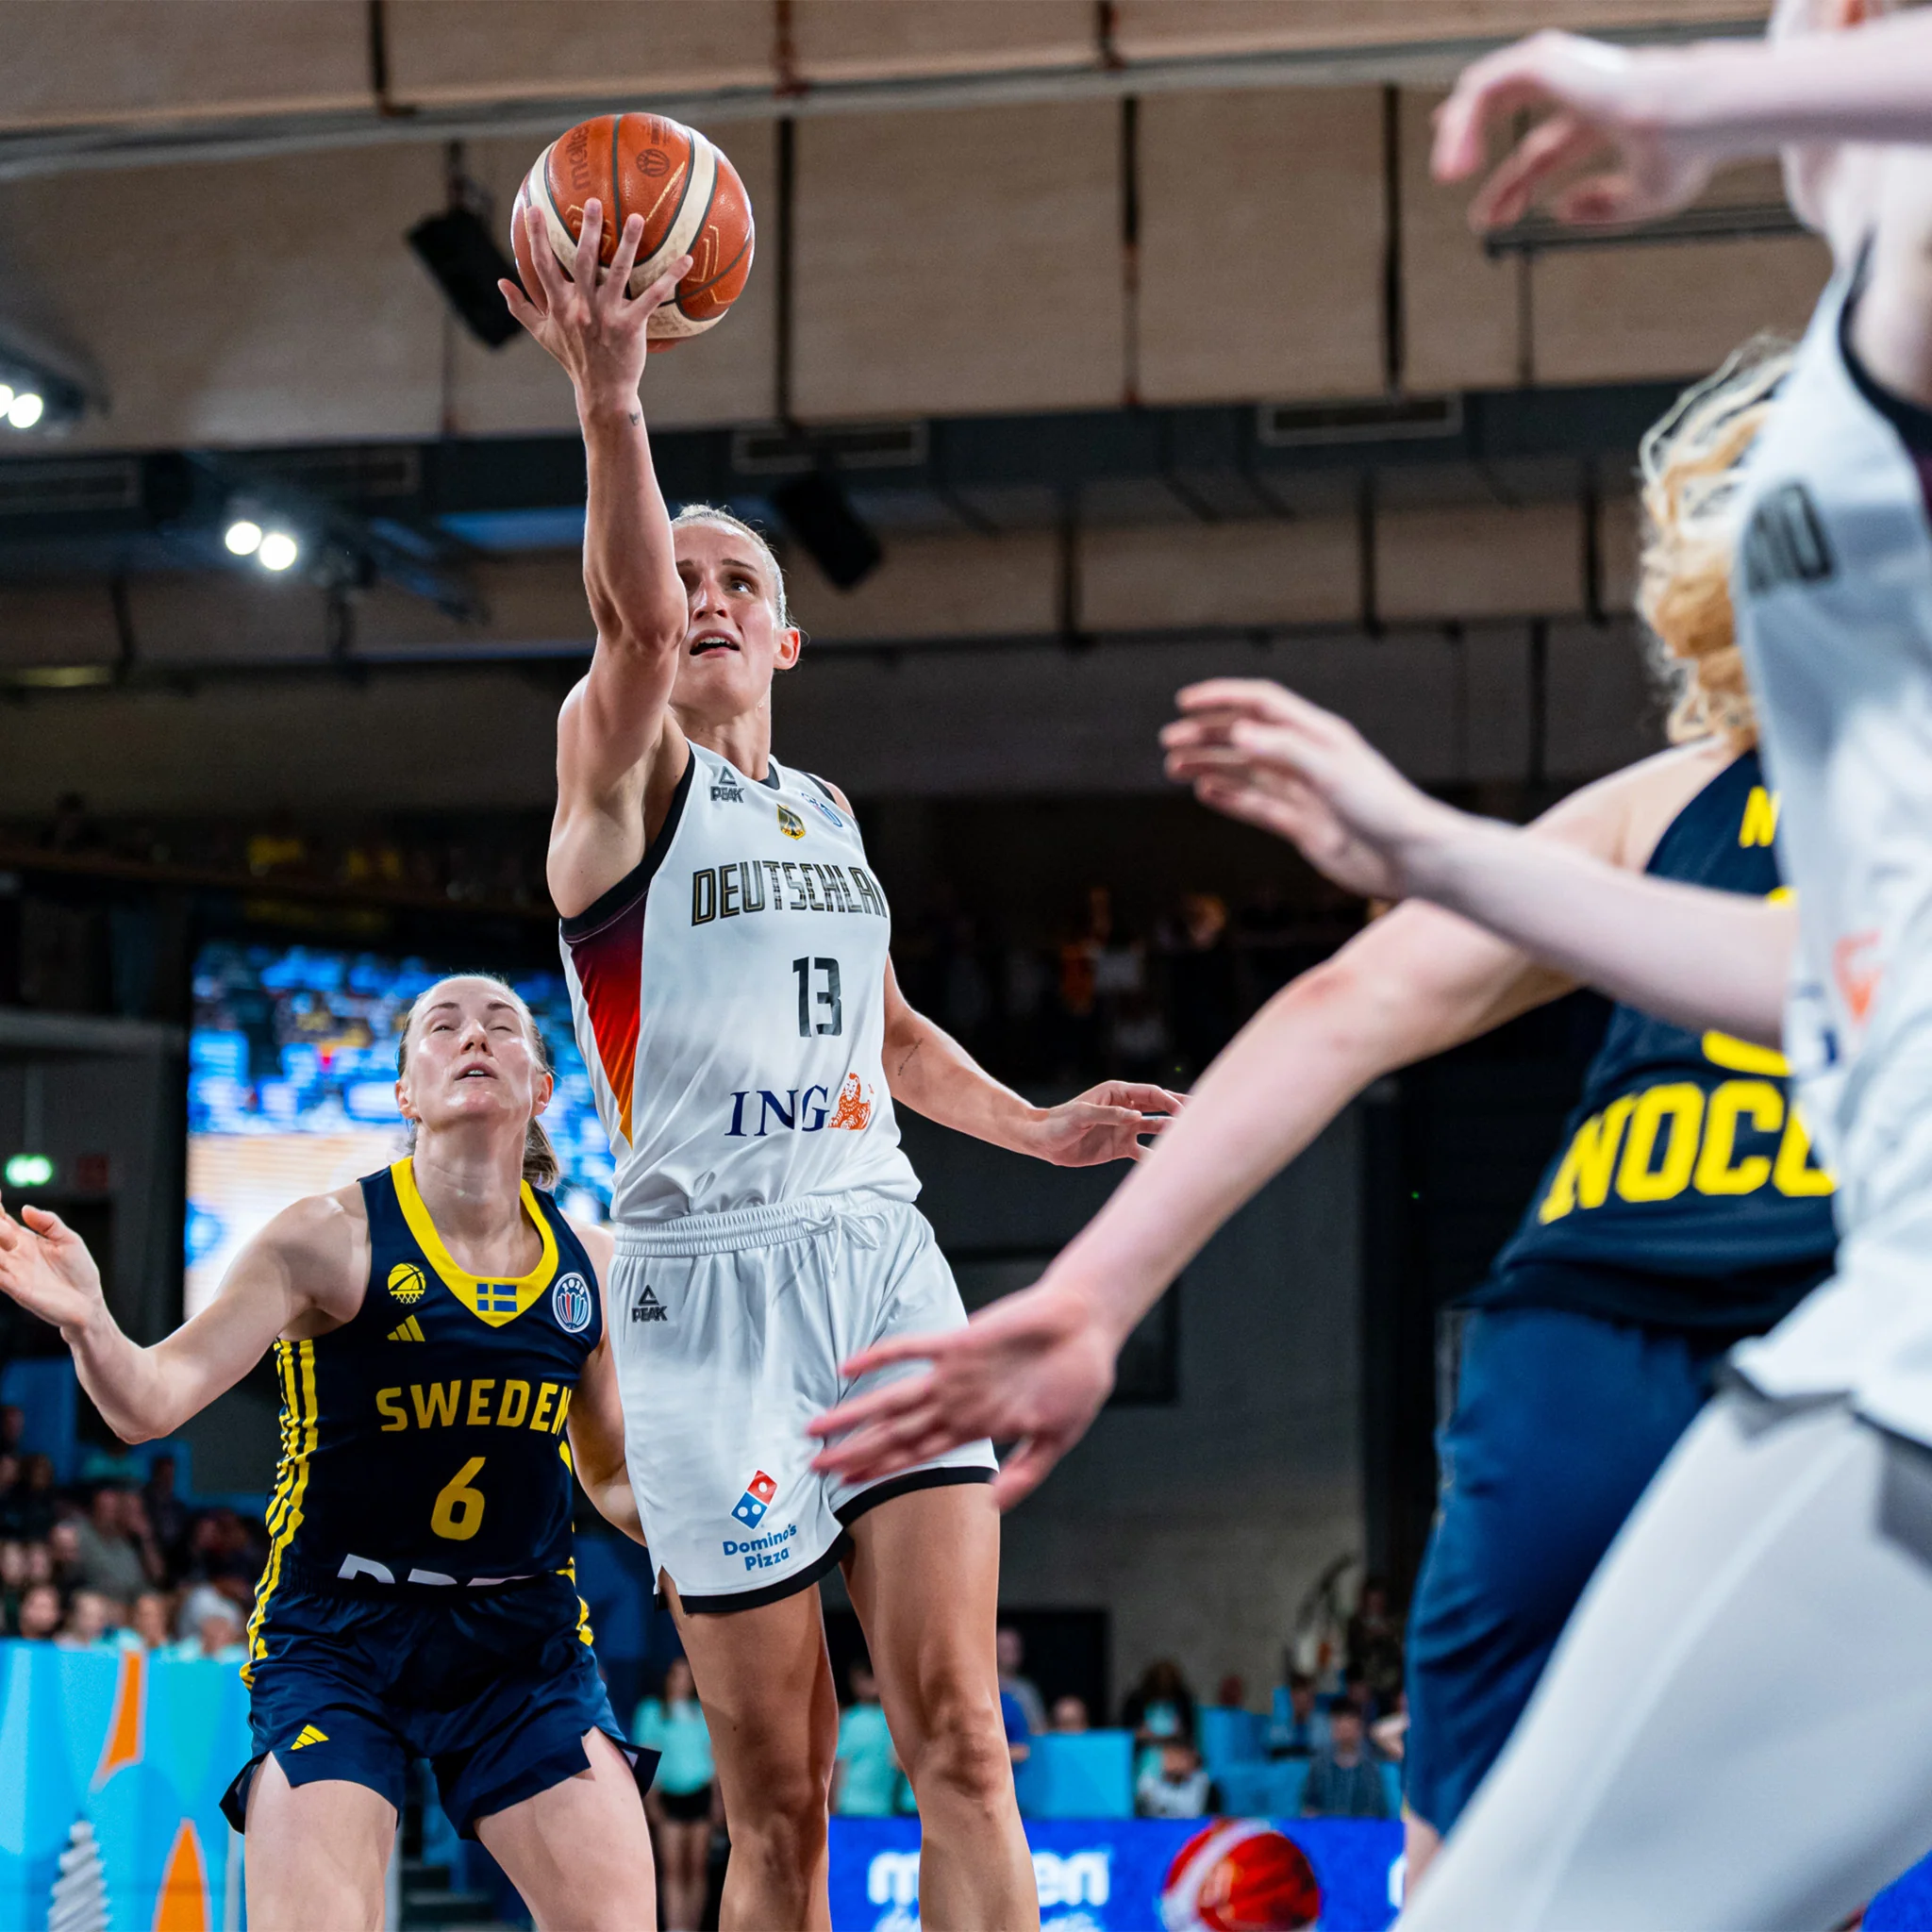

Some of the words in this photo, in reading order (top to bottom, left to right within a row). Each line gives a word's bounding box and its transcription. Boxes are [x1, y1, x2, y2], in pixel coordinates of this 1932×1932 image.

[710, 786, 745, 803] PEAK
[792, 956, 842, 1038] 13
[724, 1085, 830, 1137] ING
[631, 1305, 668, 1323] PEAK
[375, 1378, 573, 1436] SWEDEN
[430, 1457, 487, 1541] 6
[723, 1524, 797, 1556] Domino's
[744, 1553, 790, 1572] Pizza
